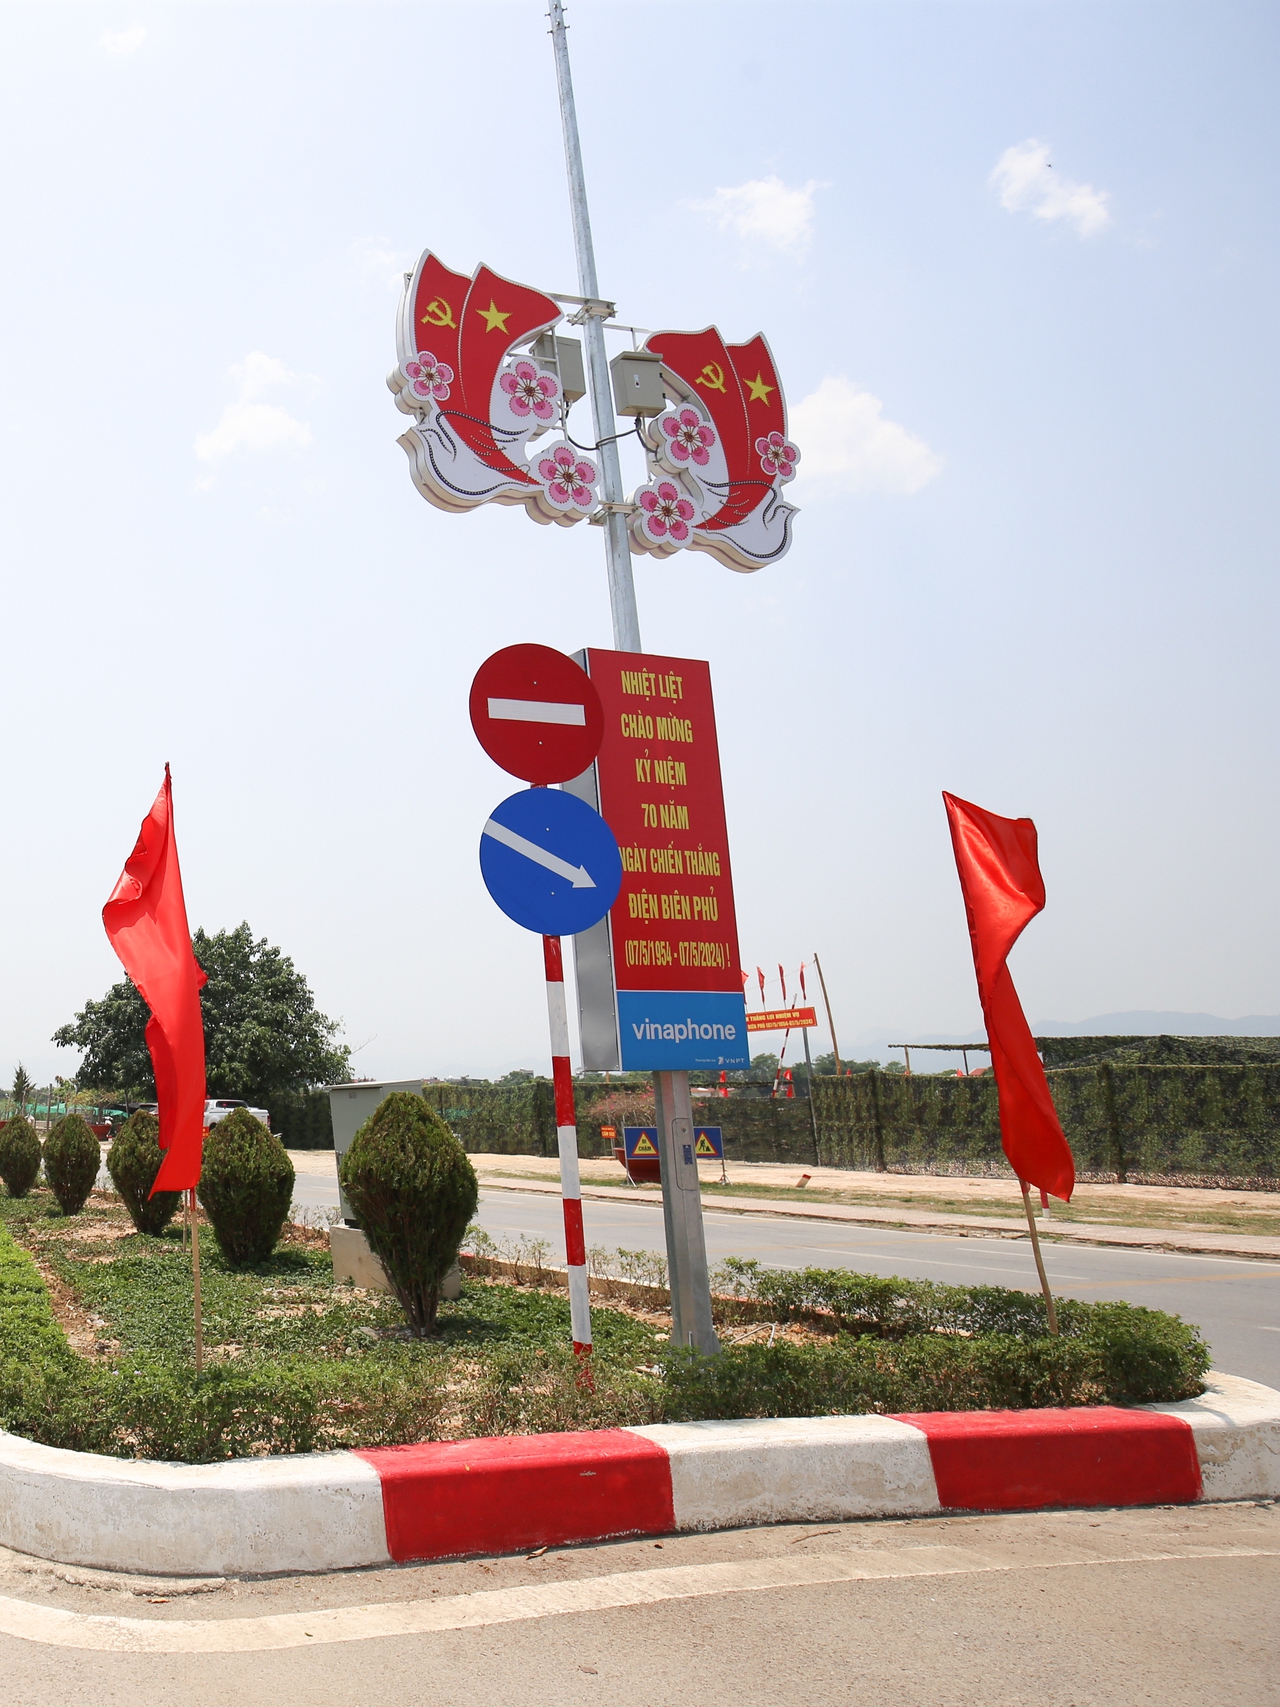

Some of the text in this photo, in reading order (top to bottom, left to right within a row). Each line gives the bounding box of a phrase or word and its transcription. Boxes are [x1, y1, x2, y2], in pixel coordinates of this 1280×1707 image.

[621, 668, 683, 704] NHIỆT LIỆT
[621, 710, 693, 743] CHÀO MỪNG
[635, 749, 687, 790] KỶ NIỆM
[641, 800, 690, 830] 70 NĂM
[618, 841, 721, 877] NGÀY CHIẾN THẮNG
[628, 886, 719, 924] ĐIỆN BIÊN PHỦ
[625, 940, 672, 968] (07/5/1954
[632, 1018, 736, 1043] vinaphone
